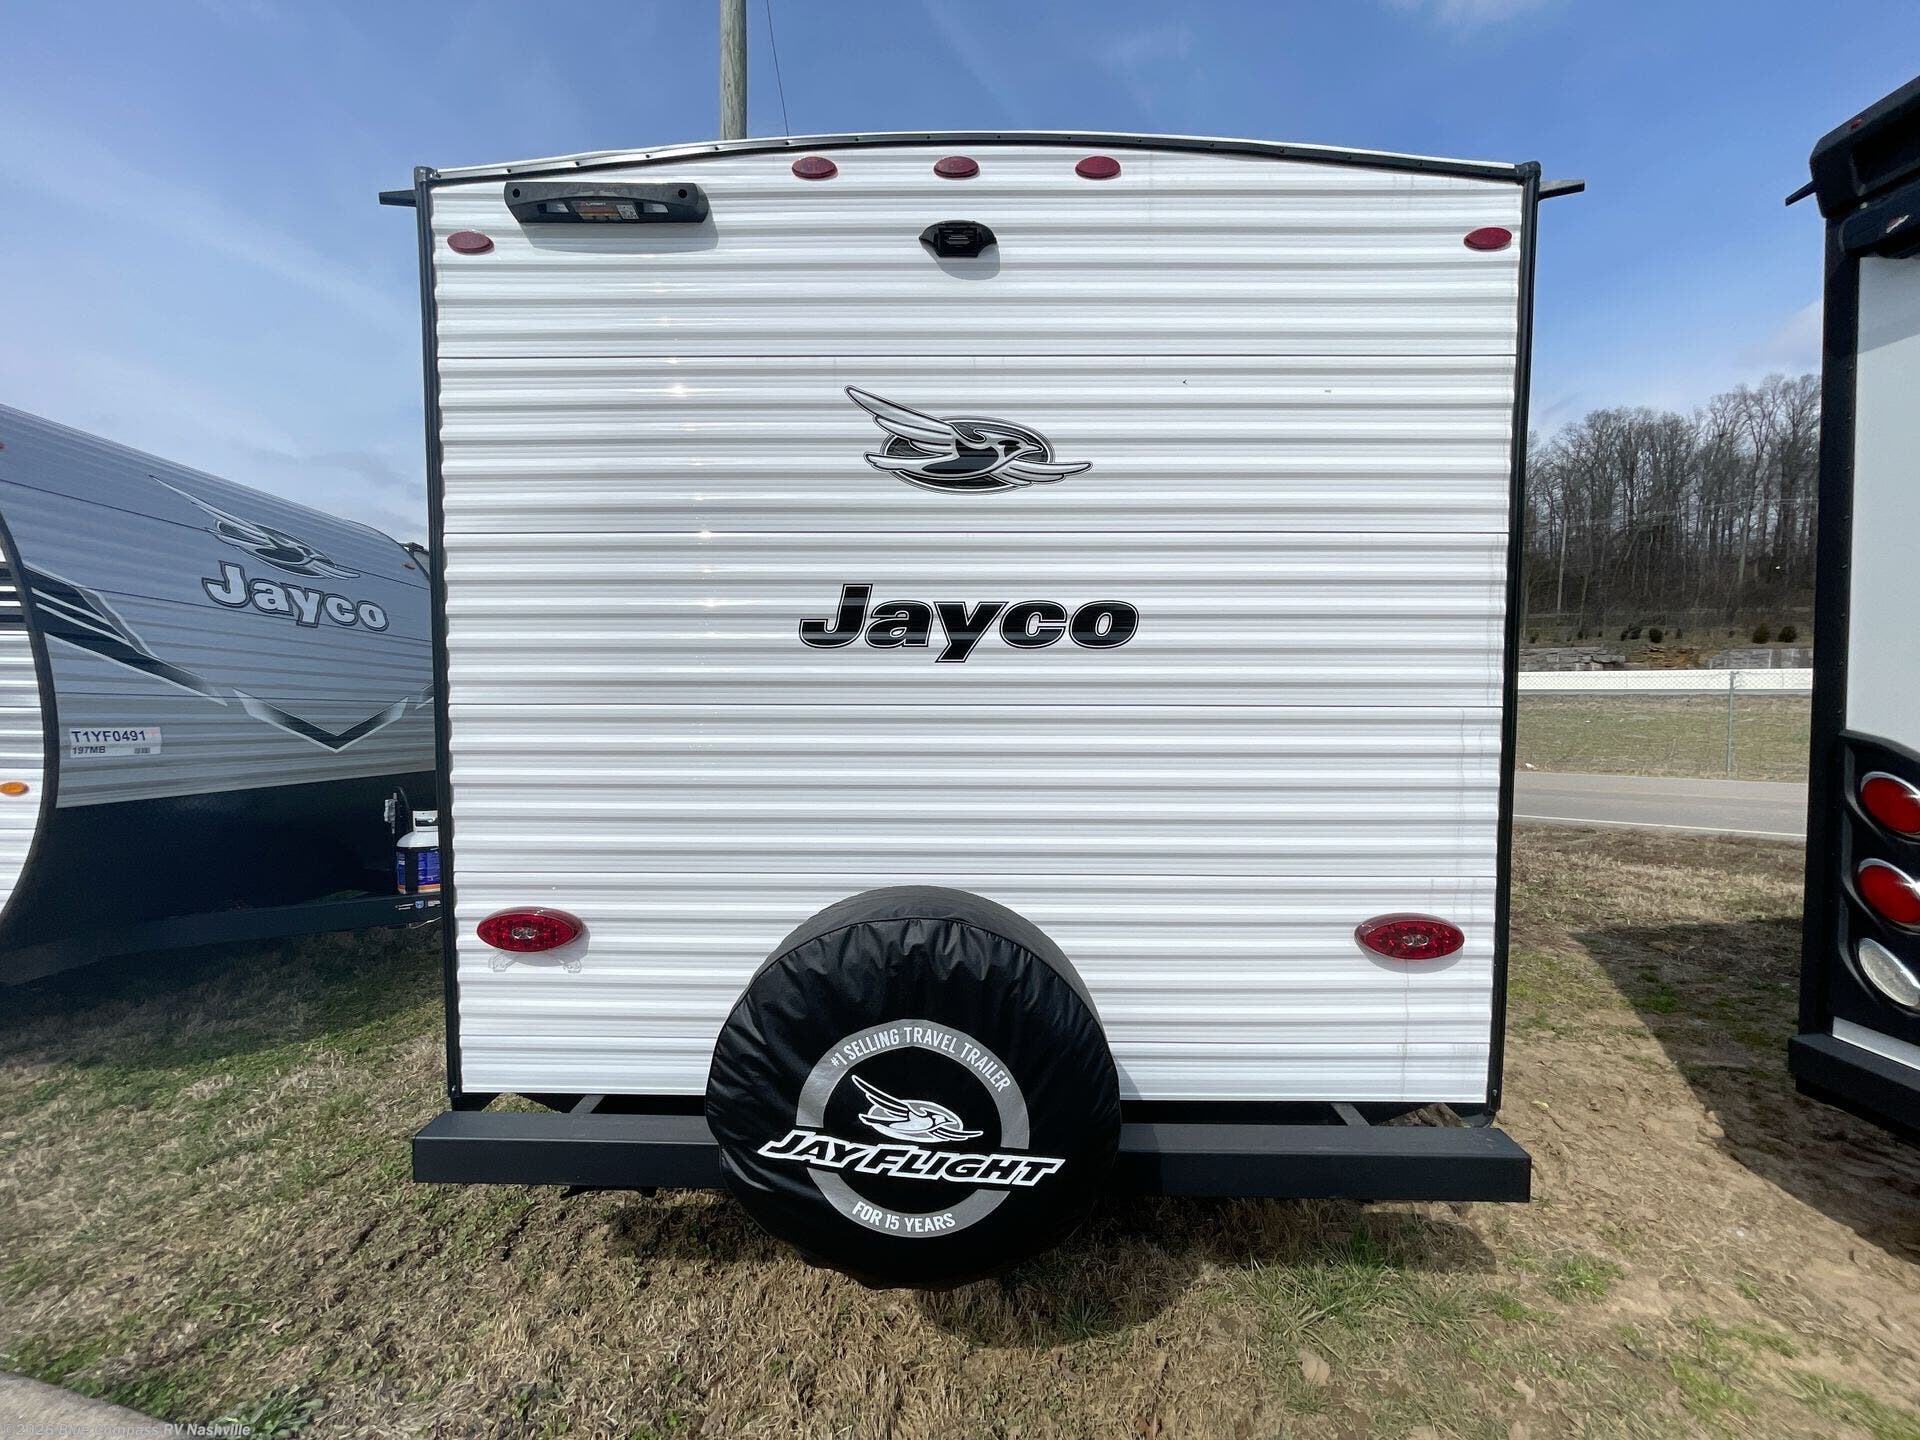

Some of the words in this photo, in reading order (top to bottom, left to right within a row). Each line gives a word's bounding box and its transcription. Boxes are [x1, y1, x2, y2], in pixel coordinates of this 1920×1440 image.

[202, 560, 389, 632] Jayco
[799, 583, 1139, 663] Jayco
[71, 730, 146, 743] T1YF0491
[830, 1051, 848, 1067] #1
[843, 1028, 900, 1061] SELLING
[904, 1026, 957, 1054] TRAVEL
[959, 1042, 1011, 1093] TRAILER
[852, 1201, 882, 1226] FOR
[885, 1214, 900, 1230] 15
[904, 1213, 956, 1233] YEARS
